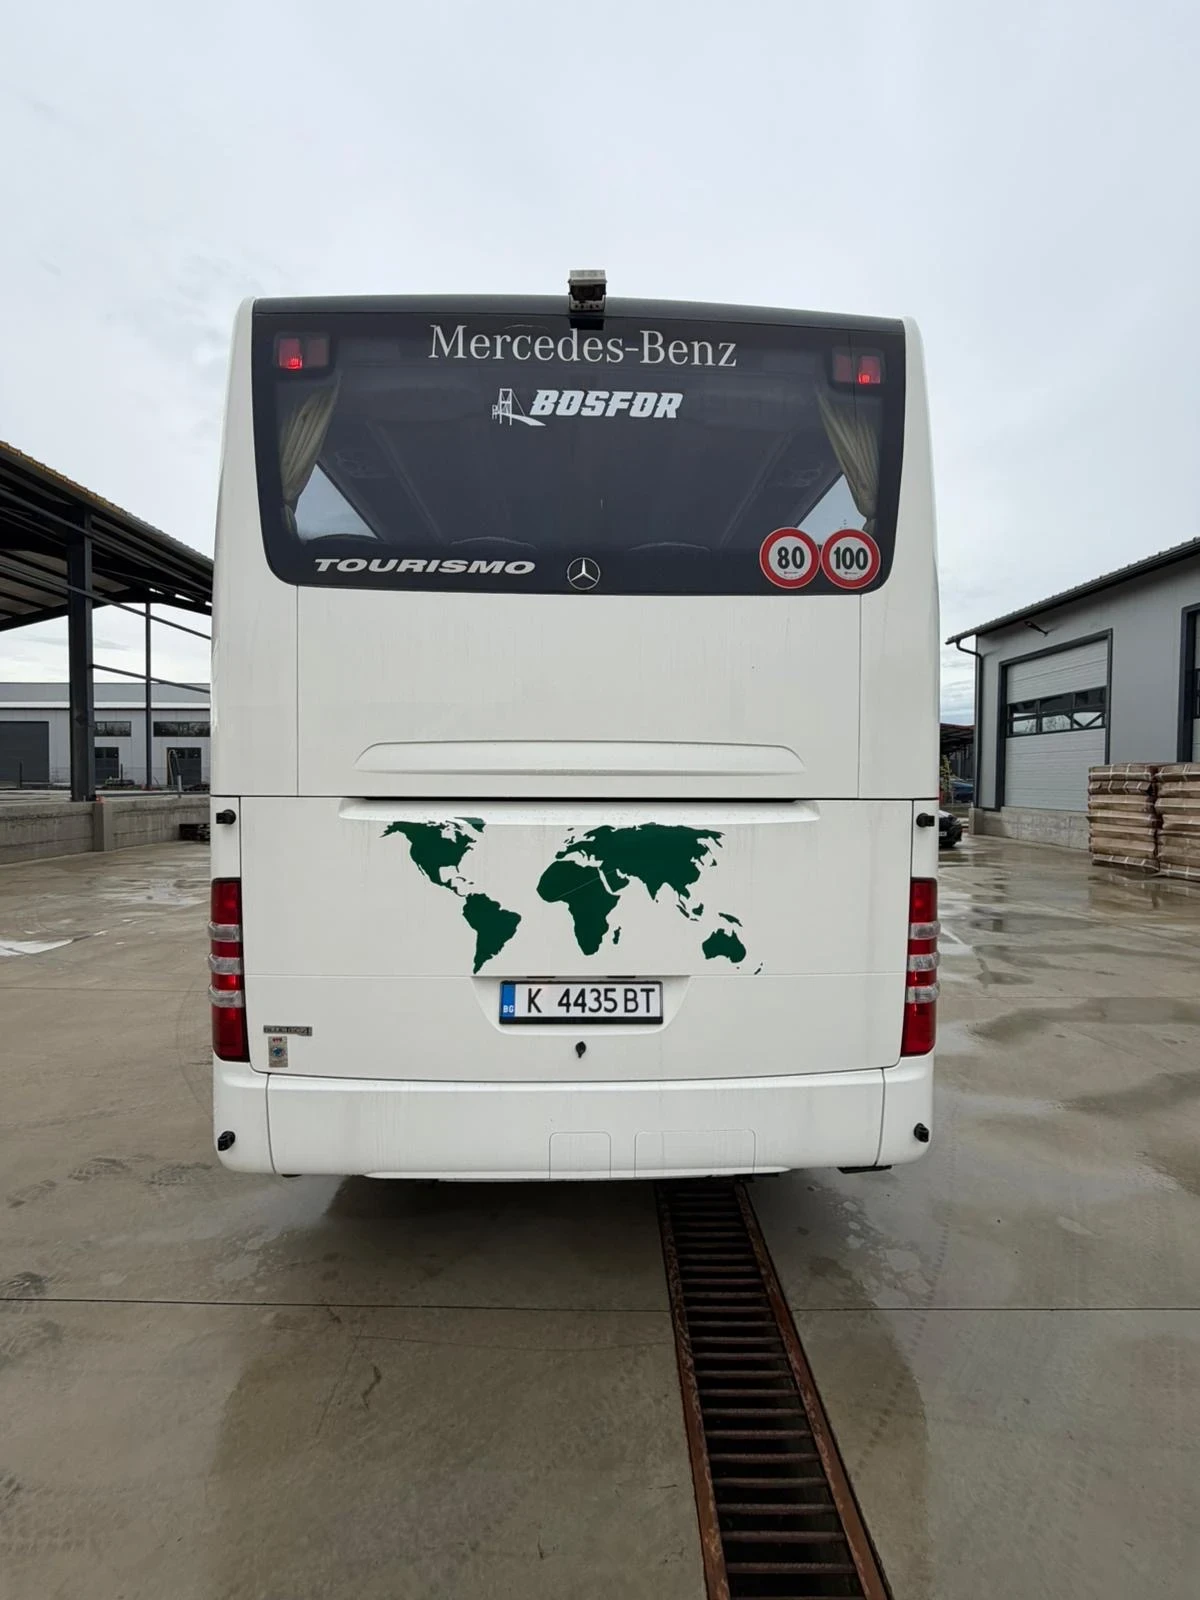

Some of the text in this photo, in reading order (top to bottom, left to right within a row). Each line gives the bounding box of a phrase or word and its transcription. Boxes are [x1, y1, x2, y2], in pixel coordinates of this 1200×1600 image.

[428, 325, 737, 367] Mercedes-Benz
[530, 389, 684, 419] BOSFOR
[315, 558, 536, 575] TOURISMO
[777, 545, 805, 570] 80
[833, 546, 869, 570] 100
[503, 1004, 514, 1013] BG
[527, 988, 542, 1013] K
